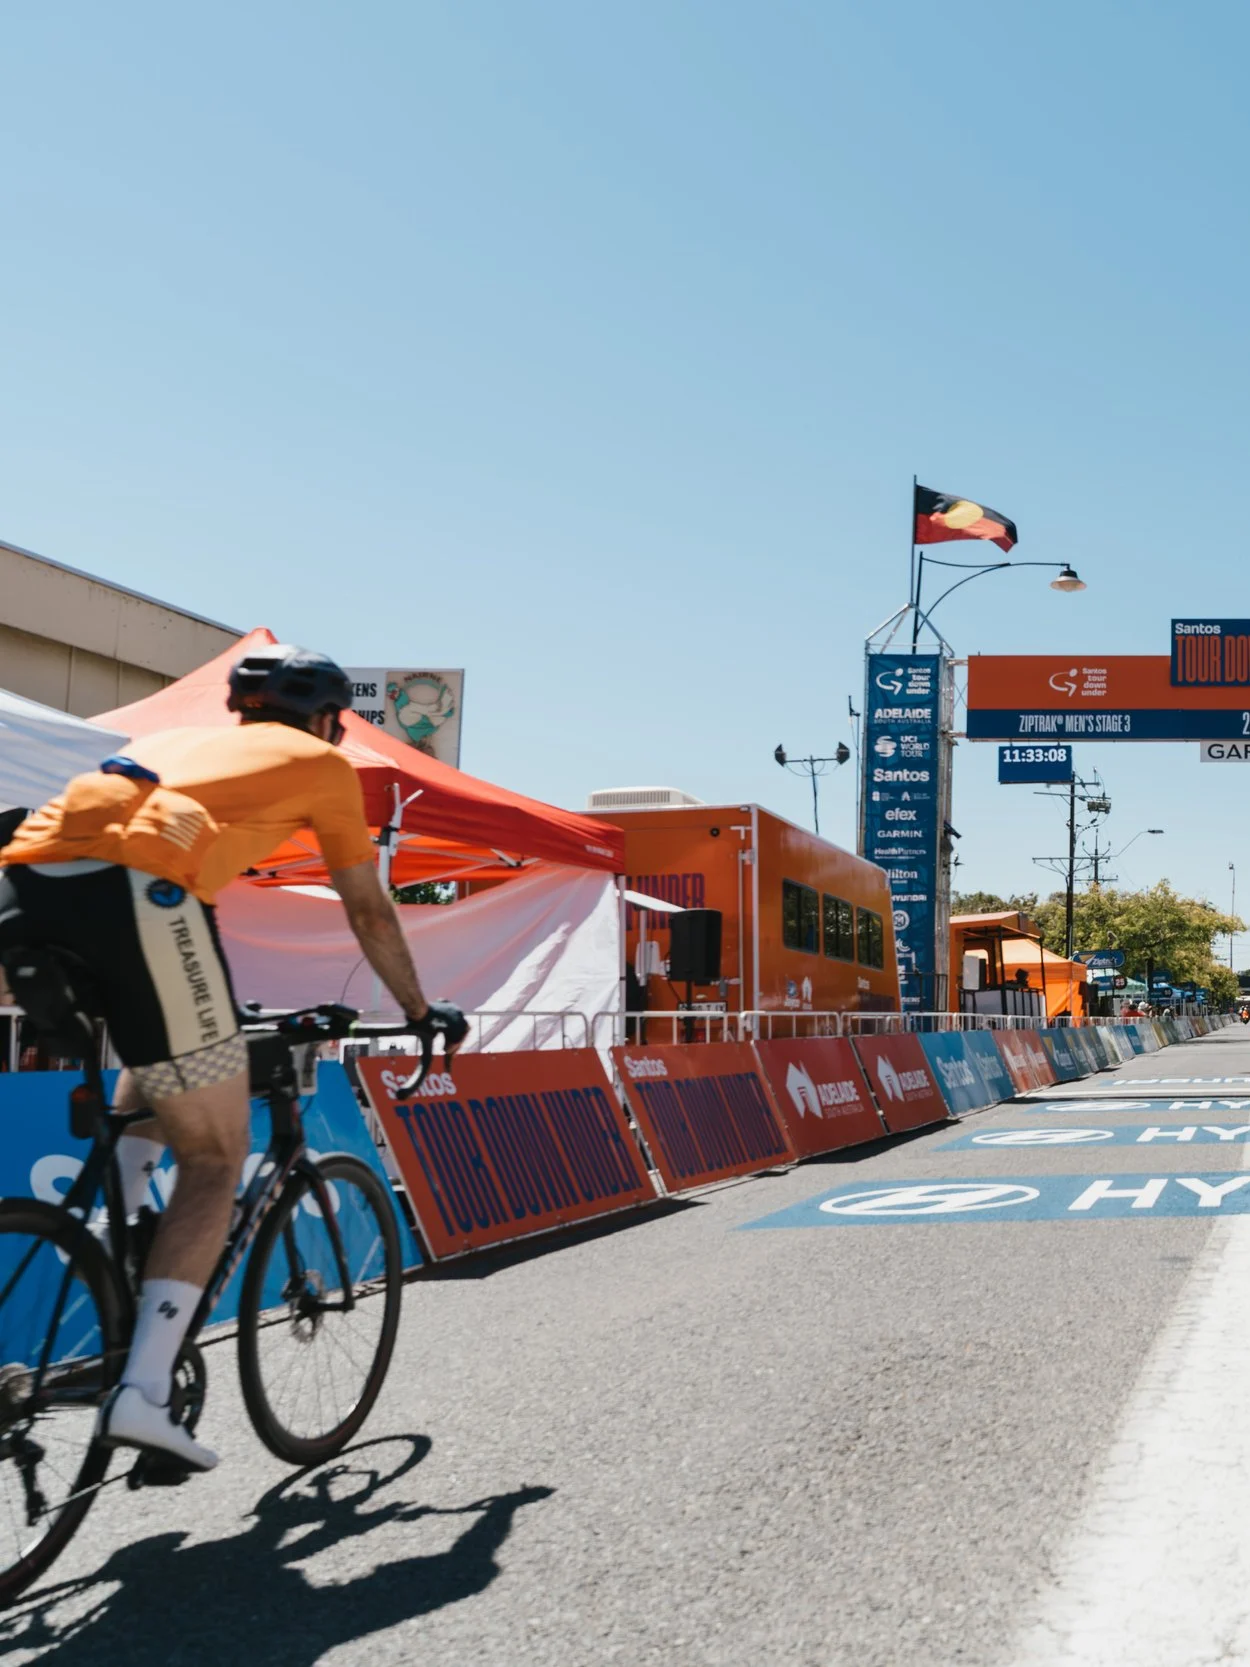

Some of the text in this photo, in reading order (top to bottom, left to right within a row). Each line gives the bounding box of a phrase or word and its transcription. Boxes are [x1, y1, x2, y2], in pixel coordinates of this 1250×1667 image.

[1175, 623, 1221, 634] Santos
[1175, 635, 1221, 682] TOUR
[874, 708, 932, 719] ADELAIDE
[1065, 715, 1094, 732] MEN'S
[1096, 715, 1122, 732] STAGE
[1124, 715, 1131, 732] 3
[1003, 749, 1067, 762] 11:33:08
[873, 768, 930, 782] Santos
[885, 807, 917, 821] efex
[877, 830, 922, 838] GARMIN
[169, 914, 220, 1042] TREASURE LIFE
[624, 1055, 668, 1078] Santos
[936, 1055, 975, 1089] Santos
[899, 1069, 930, 1091] ADELAIDE
[817, 1080, 860, 1106] ADELAIDE
[634, 1079, 705, 1179] TOUR
[393, 1099, 509, 1237] TOUR
[470, 1092, 579, 1221] DOWN
[541, 1086, 643, 1201] UNDER
